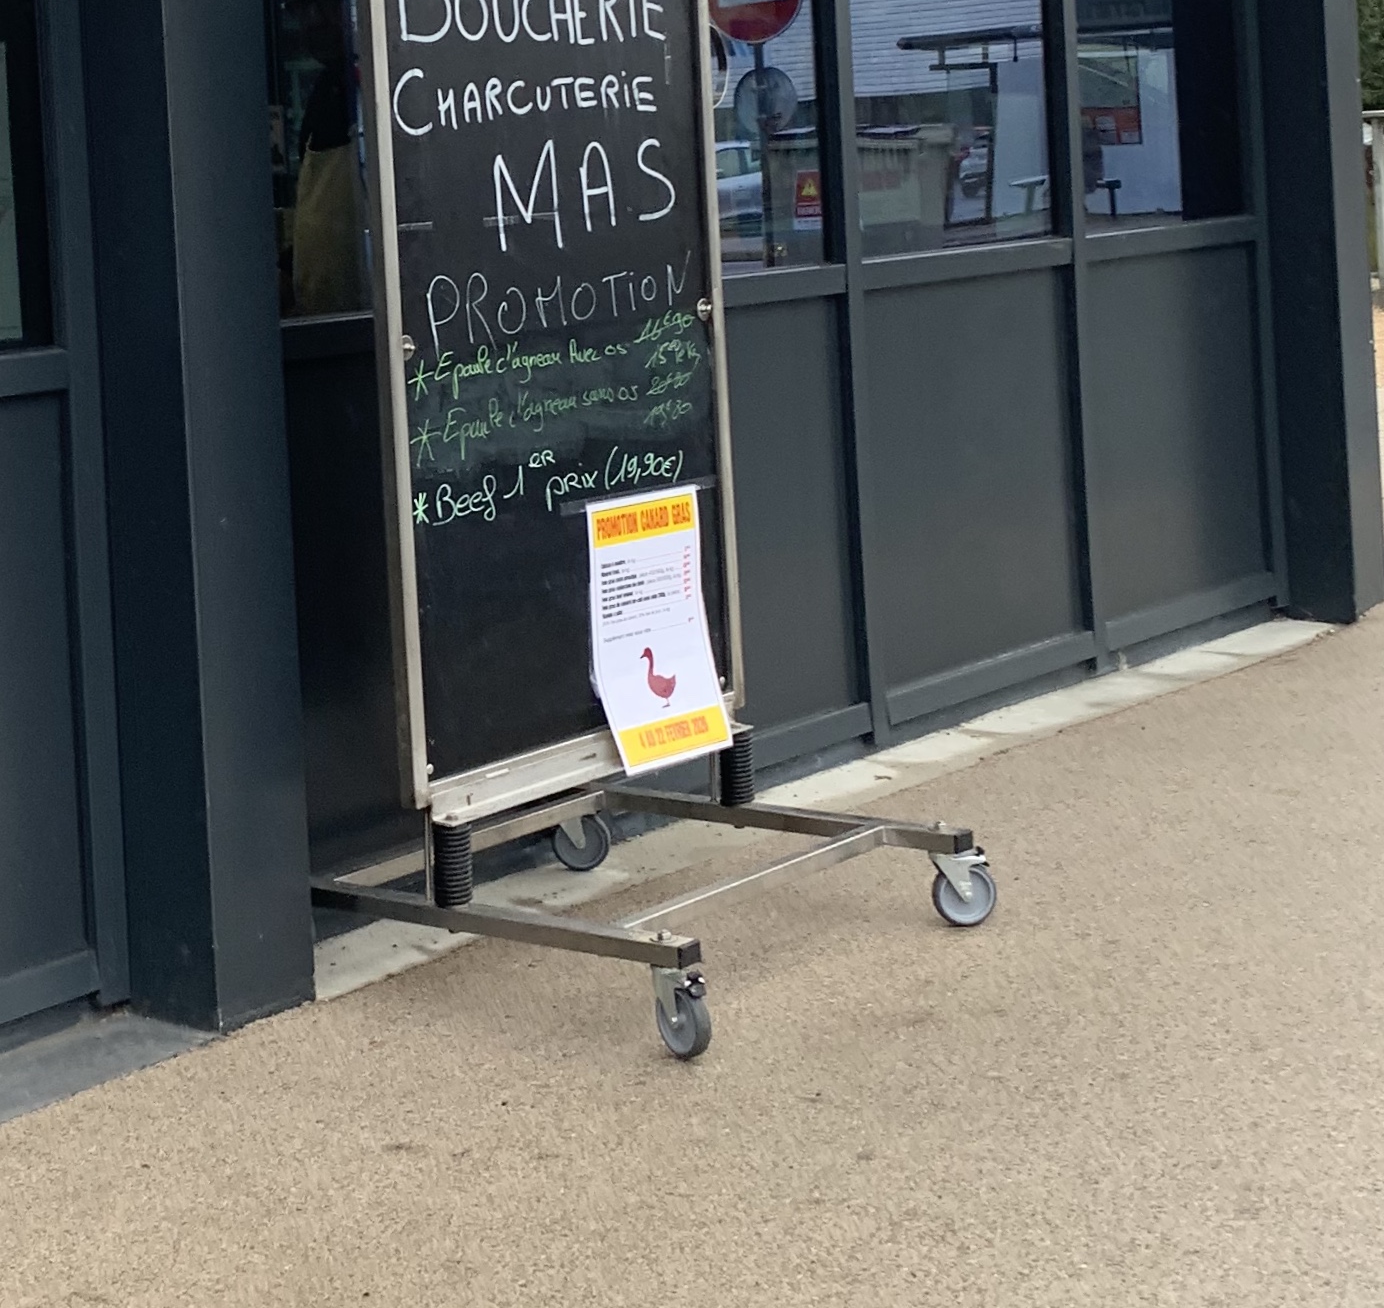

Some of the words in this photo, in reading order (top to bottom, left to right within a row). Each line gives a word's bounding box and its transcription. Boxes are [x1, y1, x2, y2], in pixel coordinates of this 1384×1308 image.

[393, 68, 657, 136] CHARCUTERIE
[493, 138, 676, 251] MAS
[426, 250, 691, 355] PROMOTION
[604, 344, 628, 355] os
[596, 511, 639, 542] PROMOTION
